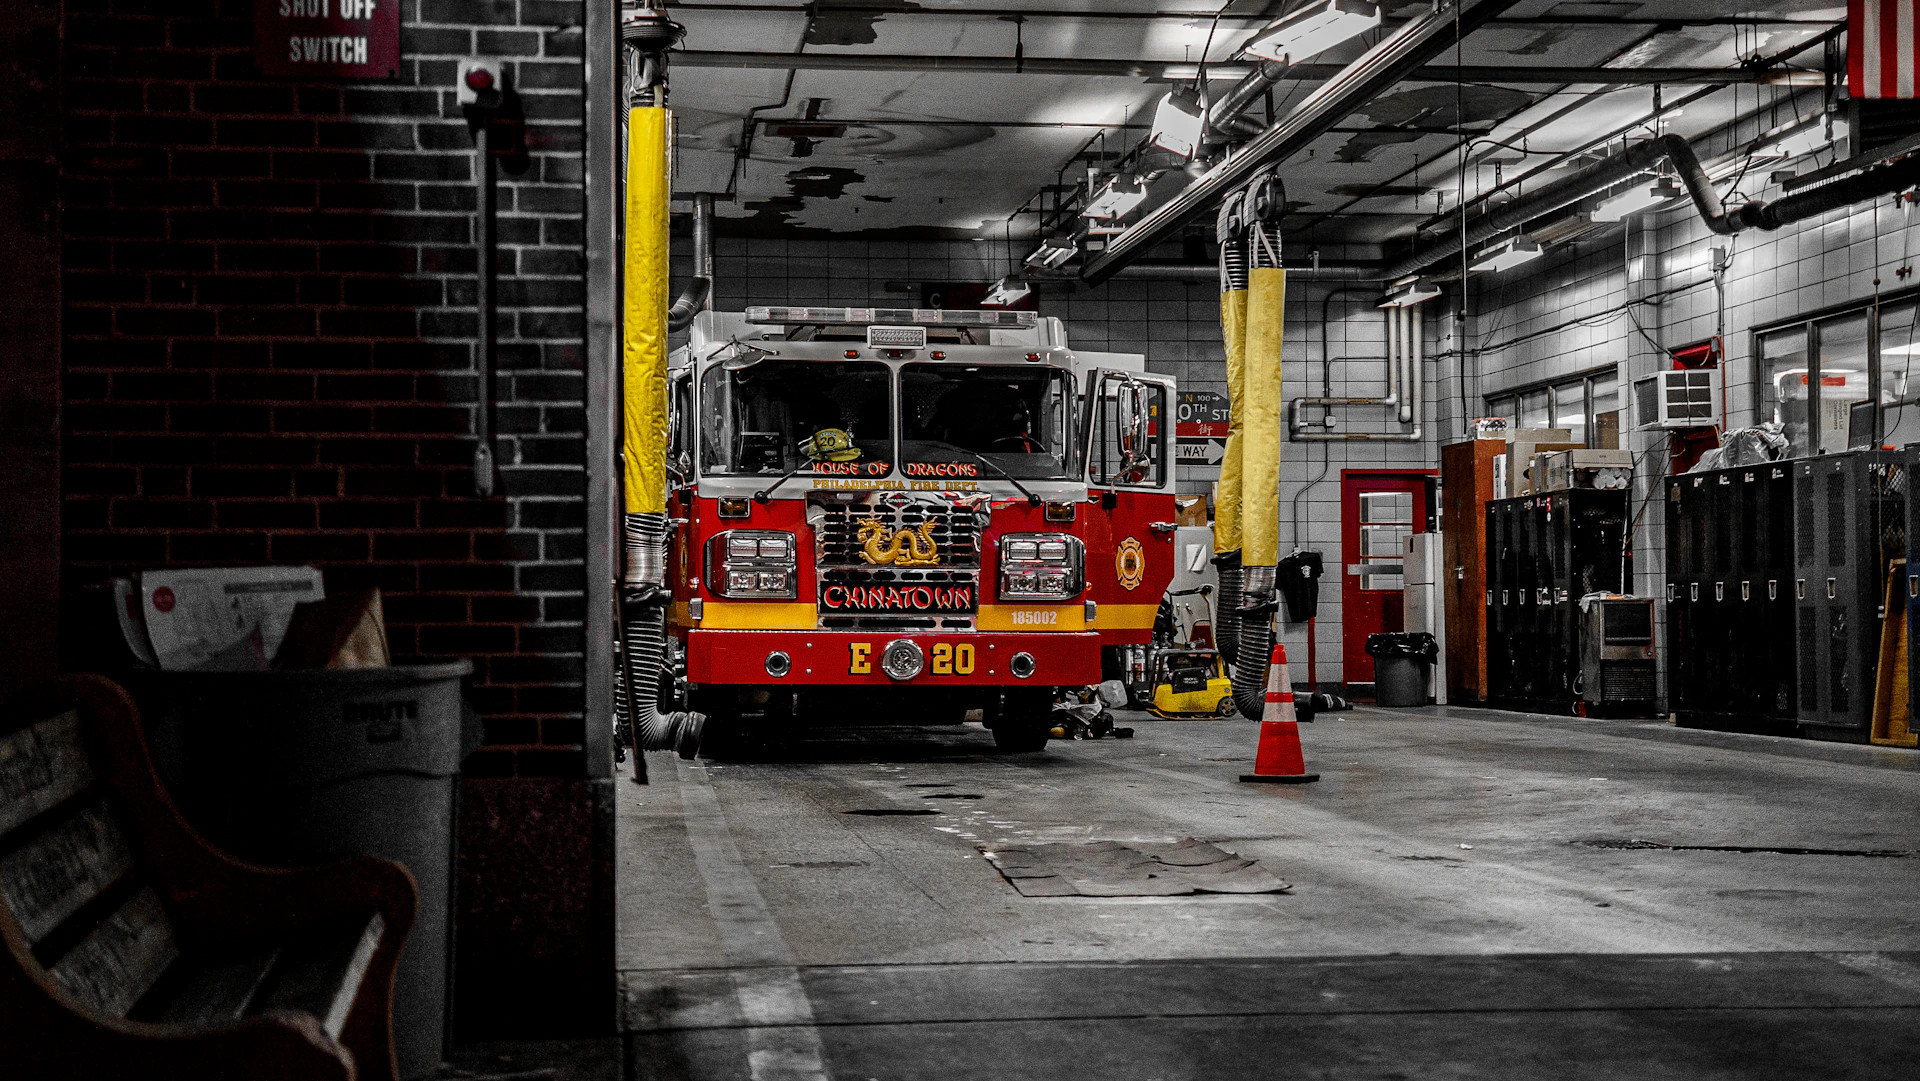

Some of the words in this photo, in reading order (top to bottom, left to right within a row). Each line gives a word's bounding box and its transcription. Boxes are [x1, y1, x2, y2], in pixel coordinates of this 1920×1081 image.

[289, 36, 368, 64] SWITCH
[1185, 394, 1193, 403] N
[1178, 404, 1207, 420] 0TH
[1212, 409, 1229, 420] ST
[820, 437, 836, 447] 20
[1183, 446, 1207, 457] WAY
[811, 461, 860, 476] HOUSE
[867, 461, 890, 476] OF
[906, 462, 979, 477] DRAGONS
[813, 479, 905, 490] PHILADELPHIA
[910, 480, 940, 491] FIRE
[945, 481, 980, 491] DEPT.
[823, 585, 971, 610] CHINATOWN
[1012, 611, 1057, 625] 185002
[850, 642, 872, 674] E
[932, 642, 976, 674] 20
